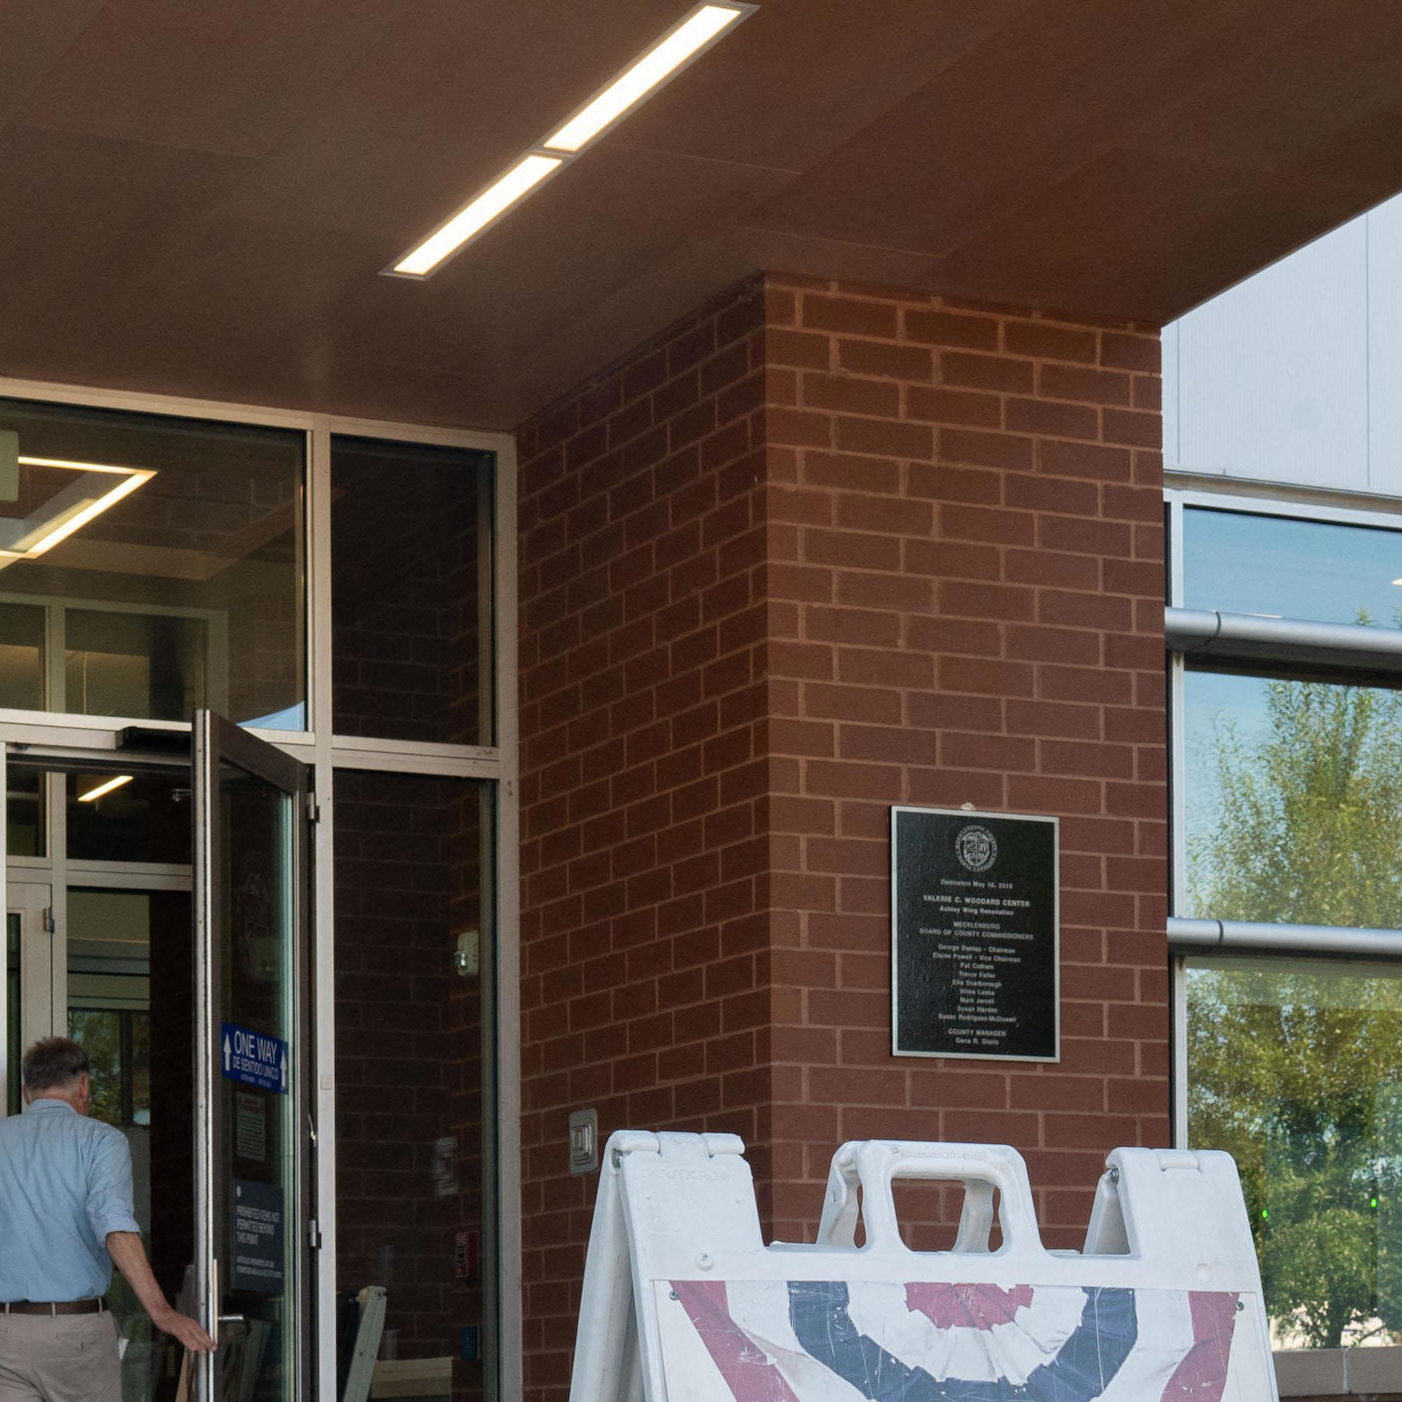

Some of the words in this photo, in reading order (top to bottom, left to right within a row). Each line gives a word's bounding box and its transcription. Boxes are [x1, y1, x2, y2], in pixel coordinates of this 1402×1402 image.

[922, 894, 952, 903] VALERIE
[964, 897, 1000, 906] WOODARD
[1002, 899, 1030, 908] CENTER
[919, 928, 941, 936] BOARD
[954, 929, 979, 938] COUNTY
[234, 1030, 255, 1059] ONE
[256, 1036, 277, 1065] WAY
